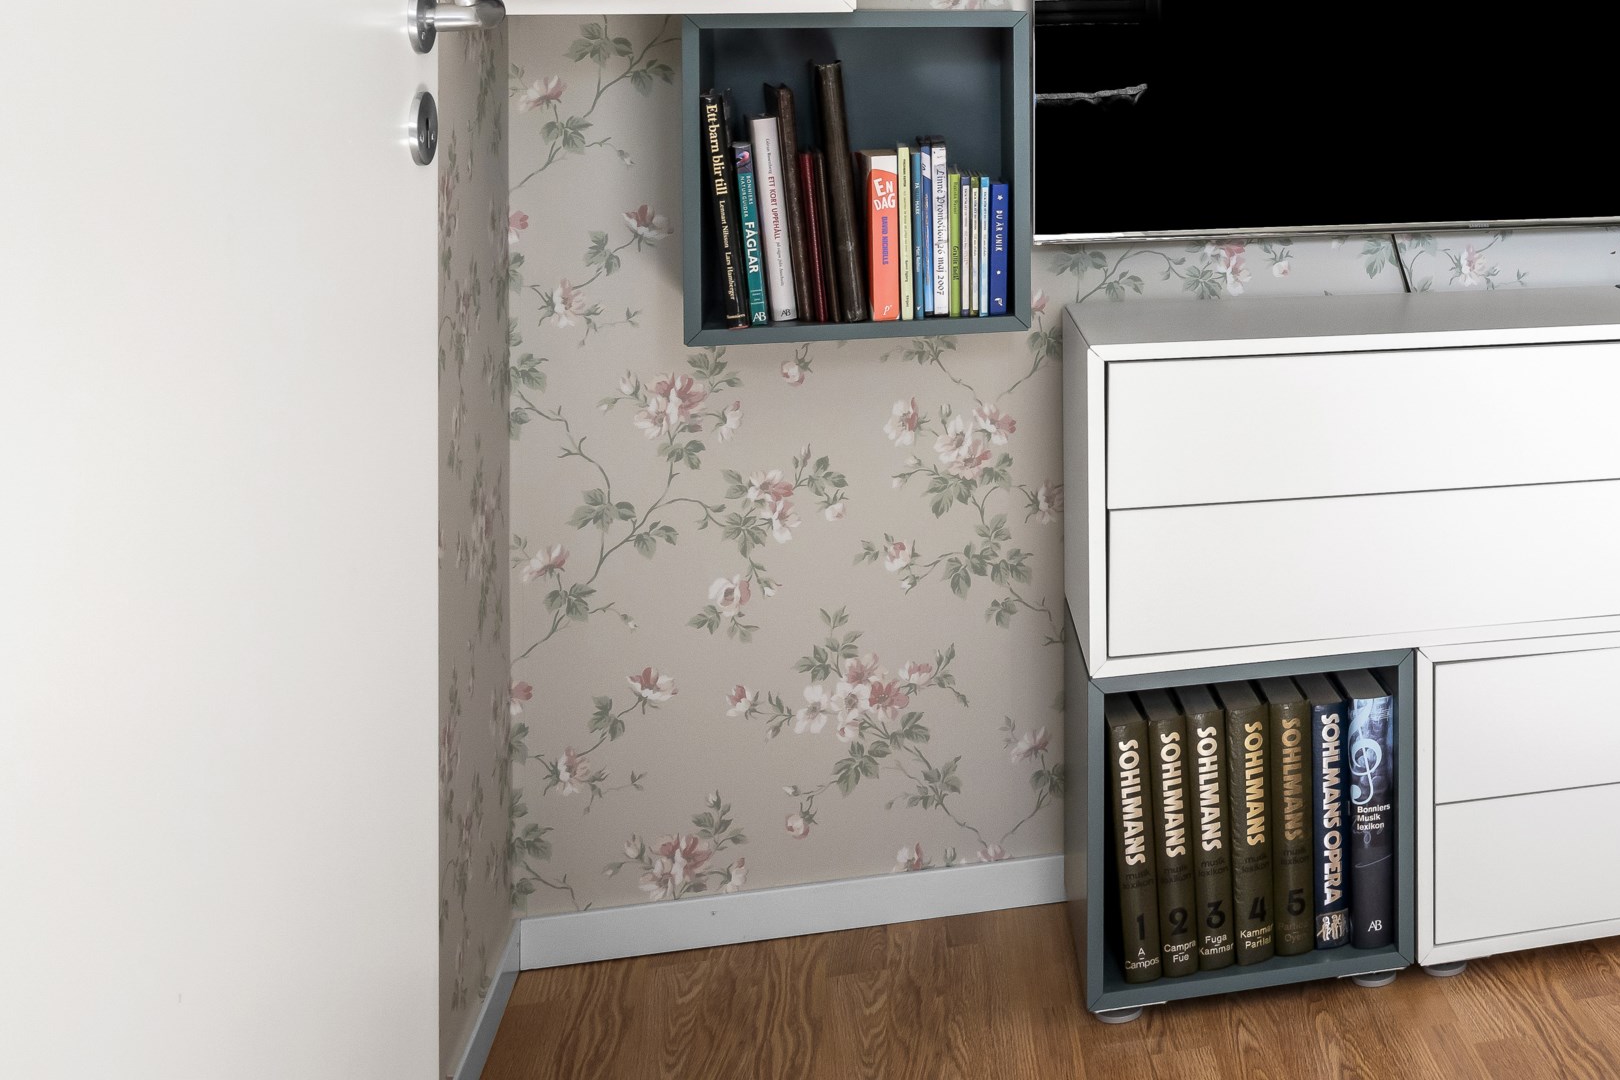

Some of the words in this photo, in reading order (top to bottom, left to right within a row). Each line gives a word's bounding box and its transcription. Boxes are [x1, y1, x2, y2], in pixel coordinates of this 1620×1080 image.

[705, 103, 719, 123] Ett
[708, 123, 723, 153] barn
[711, 154, 726, 177] blir
[714, 178, 728, 195] till
[874, 177, 893, 197] EN
[935, 167, 945, 194] Linné
[769, 188, 777, 206] KORT
[873, 192, 896, 211] DAG
[719, 199, 729, 224] Lennart
[996, 210, 1003, 220] DU
[770, 208, 781, 240] UPPEHÅLL
[881, 216, 889, 235] DAVID
[996, 221, 1004, 232] ÄR
[721, 225, 732, 248] Nilsson
[995, 233, 1003, 252] UNIK
[744, 221, 759, 273] FÅGLAR
[881, 236, 889, 265] NICHOLLS
[936, 243, 945, 255] 26
[724, 251, 734, 266] Lars
[936, 257, 946, 273] maj
[727, 266, 737, 301] Hamberger
[936, 275, 945, 296] 2007
[1281, 717, 1304, 841] SOHLMANS
[1320, 712, 1342, 830] SOHLMANS
[1196, 726, 1223, 852] SOHLMANS
[1244, 721, 1265, 847] SOHLMANS
[1118, 738, 1146, 866] SOHLMANS
[1160, 730, 1186, 859] SOHLMANS
[1356, 803, 1391, 814] Bonniers
[1356, 813, 1381, 822] Musik
[1356, 821, 1385, 831] lexikon
[1323, 830, 1343, 906] OPERA
[1249, 896, 1267, 922] 4
[1287, 888, 1306, 916] 5
[1168, 907, 1189, 936] 2
[1206, 900, 1226, 929] 3
[1136, 913, 1145, 941] 1
[1239, 924, 1273, 939] Kammar
[1367, 920, 1383, 932] AB
[1163, 939, 1197, 953] Campra
[1199, 942, 1234, 955] Kammar
[1205, 934, 1227, 946] Fuga
[1245, 937, 1272, 950] Partial
[1137, 947, 1146, 957] A
[1172, 953, 1190, 963] Fue
[1124, 956, 1160, 971] Campos
